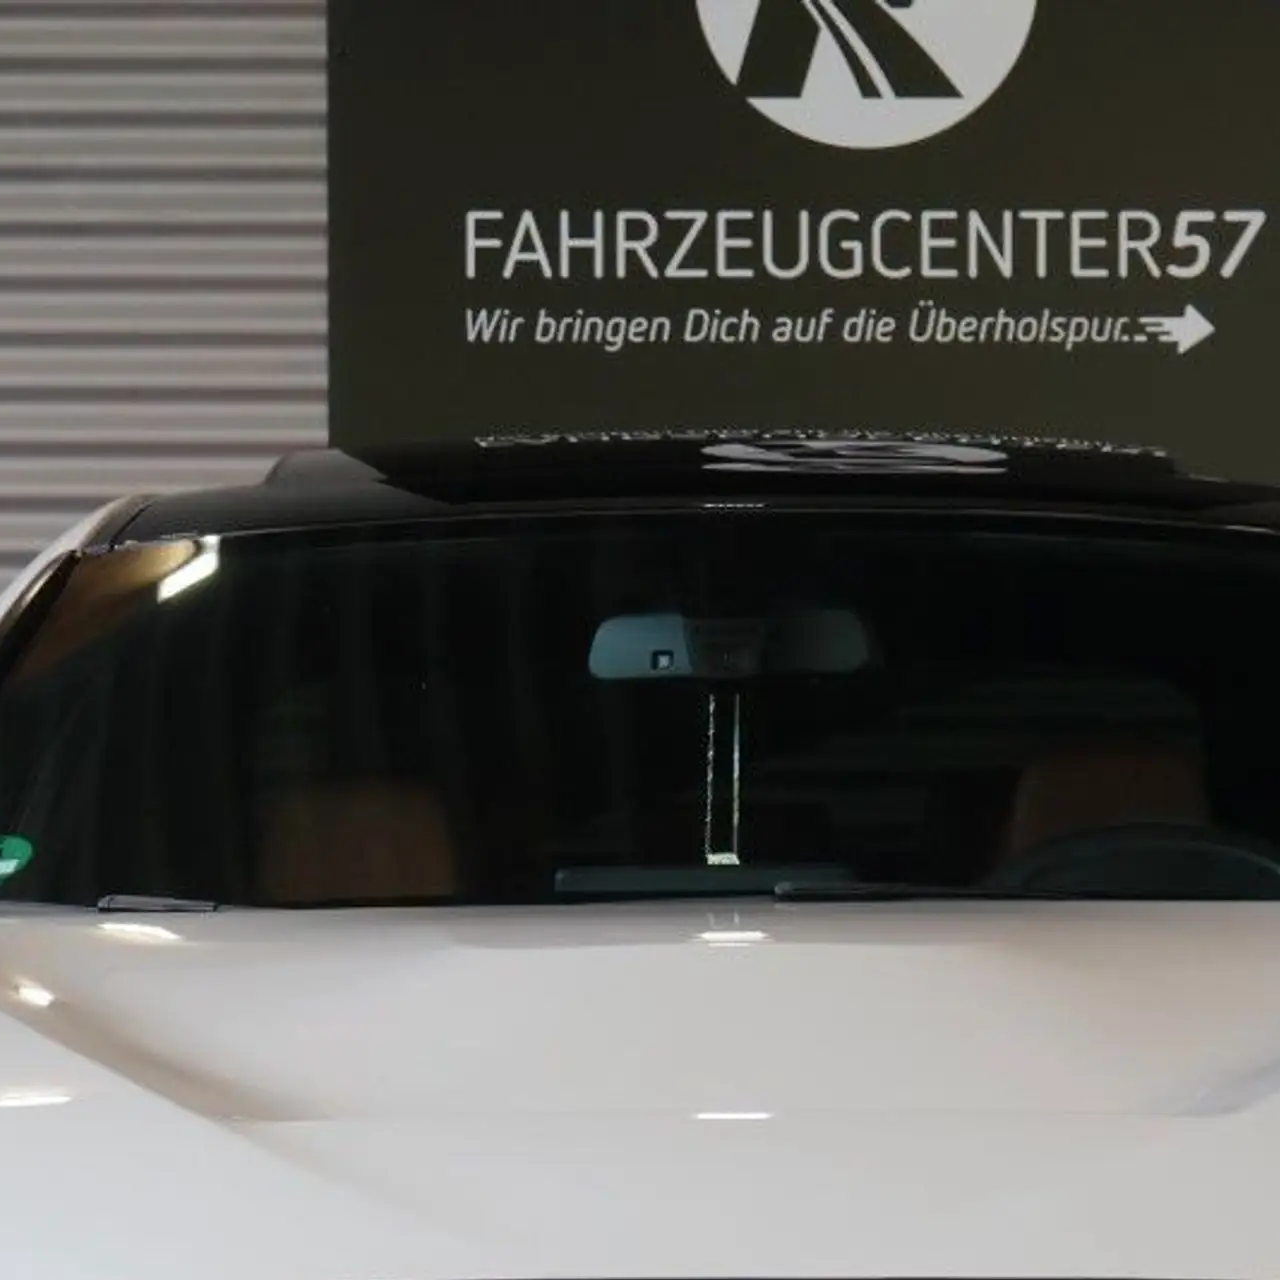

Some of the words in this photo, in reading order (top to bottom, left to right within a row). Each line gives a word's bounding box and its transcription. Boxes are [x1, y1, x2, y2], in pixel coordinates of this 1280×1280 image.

[465, 208, 1267, 280] FAHRZEUGCENTER57
[465, 308, 526, 343] Wir
[535, 308, 671, 352] bringen
[683, 308, 762, 343] Dich
[771, 308, 834, 343] auf
[843, 308, 897, 343] die
